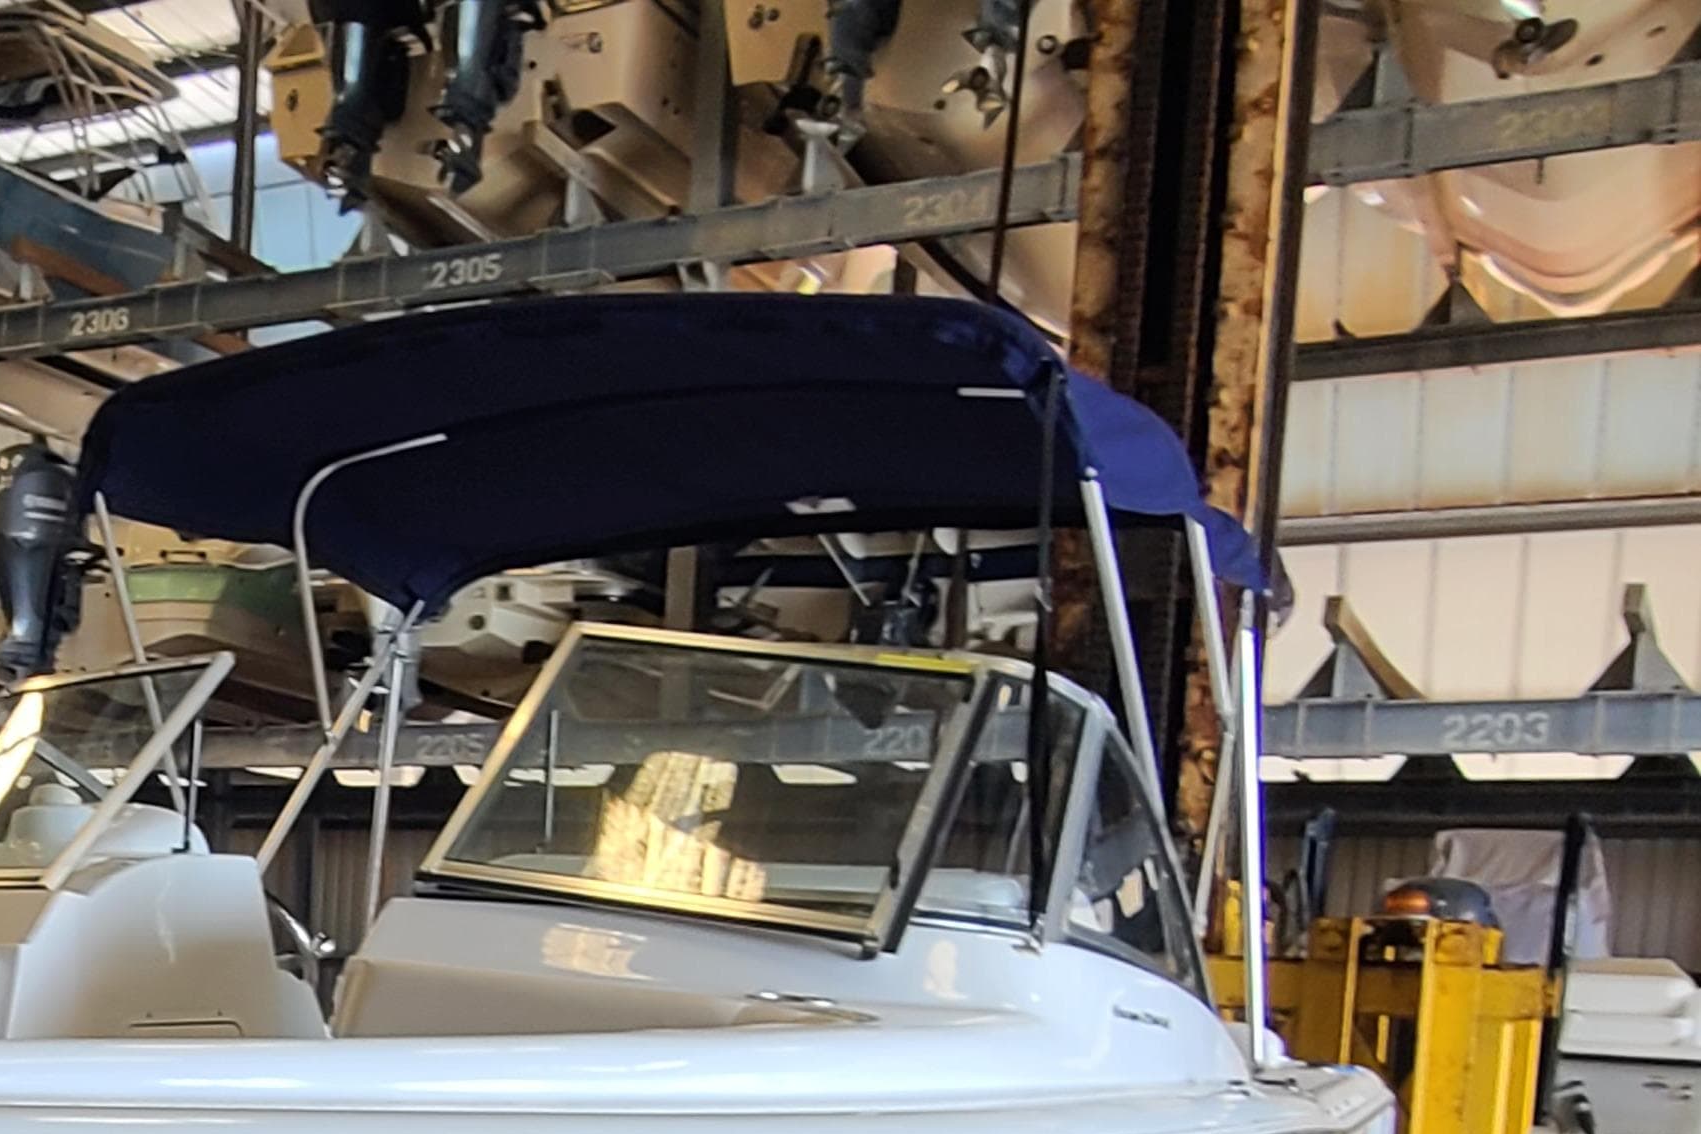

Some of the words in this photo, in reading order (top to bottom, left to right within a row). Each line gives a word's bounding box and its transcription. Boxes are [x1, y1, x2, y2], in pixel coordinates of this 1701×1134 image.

[430, 253, 503, 289] 2305
[70, 307, 130, 337] 2306
[862, 724, 925, 755] 220
[1442, 711, 1550, 746] 2203
[415, 732, 483, 761] 2205
